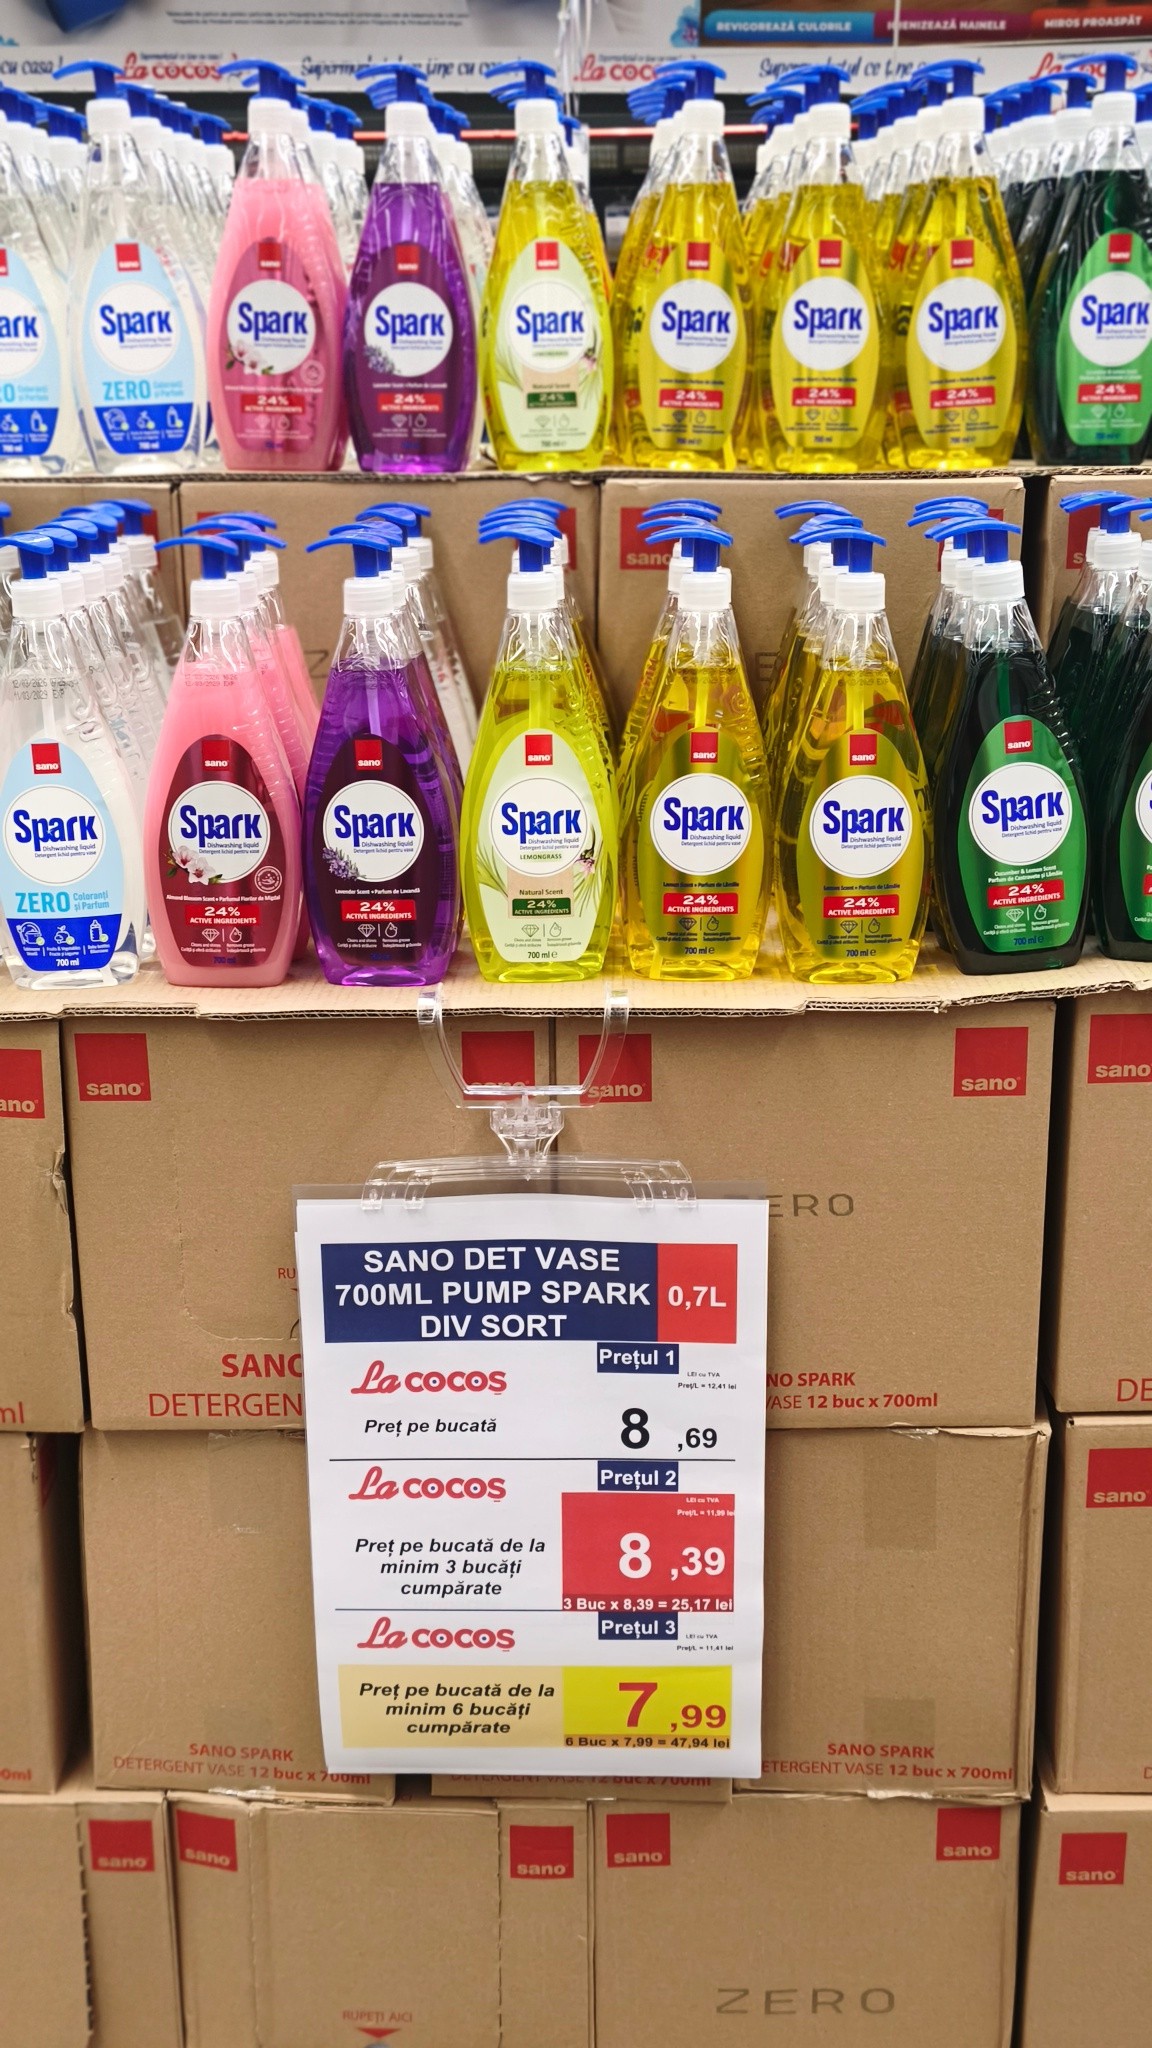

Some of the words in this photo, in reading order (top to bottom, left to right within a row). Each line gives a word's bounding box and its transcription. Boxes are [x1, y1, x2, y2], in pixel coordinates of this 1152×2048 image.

[798, 21, 852, 32] CULORILE
[960, 20, 1007, 30] HAINELE
[1044, 18, 1080, 28] MIROS
[238, 302, 308, 341] Spark
[661, 301, 731, 340] Spark
[793, 299, 862, 338] Spark
[928, 301, 998, 340] Spark
[1081, 294, 1150, 333] Spark
[99, 304, 172, 343] Spark
[375, 306, 445, 344] Spark
[516, 305, 584, 342] Spark
[102, 380, 151, 401] ZERO
[1007, 741, 1031, 749] sano
[663, 797, 745, 840] Spark
[981, 789, 1064, 831] Spark
[13, 809, 98, 851] Spark
[180, 805, 262, 848] Spark
[334, 805, 416, 847] Spark
[501, 802, 582, 844] Spark
[822, 800, 905, 842] Spark
[690, 833, 725, 842] Dishwashing
[725, 833, 741, 841] liquid
[1008, 884, 1045, 896] 24%
[15, 892, 70, 913] ZERO
[359, 901, 396, 912] 24%
[683, 895, 719, 905] 24%
[843, 897, 880, 908] 24%
[204, 907, 240, 916] 24%
[528, 951, 540, 959] 700
[541, 951, 550, 959] ml
[1095, 1063, 1151, 1078] sano
[86, 1082, 142, 1096] sano
[588, 1083, 643, 1098] sano
[961, 1076, 1018, 1092] sano
[0, 1100, 36, 1113] ano
[766, 1193, 854, 1217] ERO
[364, 1249, 454, 1273] SANO
[464, 1246, 527, 1271] DET
[537, 1246, 620, 1271] VASE
[335, 1282, 432, 1307] 700ML
[443, 1281, 531, 1305] PUMP
[541, 1281, 651, 1306] SPARK
[667, 1285, 727, 1311] 0,7L
[421, 1316, 472, 1338] DIV
[481, 1314, 567, 1338] SORT
[599, 1348, 658, 1370] Prețul
[666, 1350, 674, 1366] 1
[350, 1360, 401, 1395] La
[707, 1383, 726, 1391] 12,41
[766, 1373, 793, 1387] NO
[798, 1372, 856, 1387] SPARK
[149, 1393, 303, 1417] DETERGEN
[807, 1395, 827, 1409] 12
[832, 1394, 866, 1408] buc
[868, 1398, 879, 1408] x
[883, 1393, 938, 1408] 700ml
[365, 1419, 402, 1438] Preț
[407, 1421, 430, 1436] pe
[435, 1418, 497, 1433] bucată
[620, 1408, 650, 1449] 8
[677, 1428, 718, 1452] ,69
[348, 1465, 399, 1500] La
[600, 1470, 659, 1490] Prețul
[665, 1471, 677, 1486] 2
[1093, 1490, 1145, 1504] sano
[355, 1538, 395, 1557] Preț
[400, 1541, 423, 1556] pe
[429, 1538, 494, 1553] bucată
[500, 1538, 523, 1553] de
[529, 1538, 545, 1553] la
[618, 1532, 652, 1579] 8
[670, 1546, 726, 1581] ,39
[380, 1559, 439, 1574] minim
[445, 1560, 456, 1574] 3
[462, 1559, 522, 1579] bucăți
[401, 1580, 503, 1598] cumpărate
[563, 1598, 572, 1611] 3
[576, 1598, 606, 1611] Buc
[610, 1601, 619, 1610] x
[623, 1598, 654, 1613] 8,39
[671, 1598, 710, 1613] 25,17
[715, 1598, 733, 1611] lei
[357, 1616, 407, 1649] La
[601, 1620, 659, 1639] Prețul
[665, 1620, 676, 1635] 3
[359, 1682, 400, 1700] Preț
[404, 1686, 429, 1700] pe
[435, 1683, 501, 1697] bucată
[508, 1683, 532, 1697] de
[538, 1683, 555, 1697] la
[385, 1702, 446, 1716] minim
[452, 1703, 463, 1716] 6
[470, 1702, 531, 1720] bucăți
[618, 1682, 658, 1728] 7
[670, 1704, 727, 1732] ,99
[407, 1721, 511, 1737] cumpărate
[189, 1743, 236, 1759] SANO
[239, 1745, 294, 1762] SPARK
[565, 1737, 573, 1746] 6
[578, 1737, 607, 1747] Buc
[624, 1737, 653, 1748] 7,99
[670, 1737, 709, 1749] 47,94
[714, 1737, 730, 1749] lei
[827, 1742, 876, 1756] SANO
[879, 1744, 935, 1759] SPARK
[113, 1756, 204, 1775] DETERGENT
[207, 1762, 250, 1777] VASE
[251, 1765, 269, 1780] 12
[273, 1767, 303, 1782] buc
[307, 1771, 317, 1782] x
[320, 1771, 371, 1785] 700ml
[761, 1759, 842, 1775] ETERGENT
[844, 1762, 884, 1776] VASE
[889, 1764, 909, 1777] 12
[912, 1763, 943, 1778] buc
[946, 1767, 957, 1778] x
[961, 1766, 1013, 1781] 700ml
[185, 1848, 230, 1866] sano
[614, 1851, 663, 1864] sano
[943, 1845, 992, 1857] sano
[98, 1856, 147, 1869] sano
[517, 1863, 566, 1876] sano
[1065, 1869, 1116, 1881] sano
[715, 1987, 896, 2015] ZERO
[389, 2010, 413, 2023] AICI
